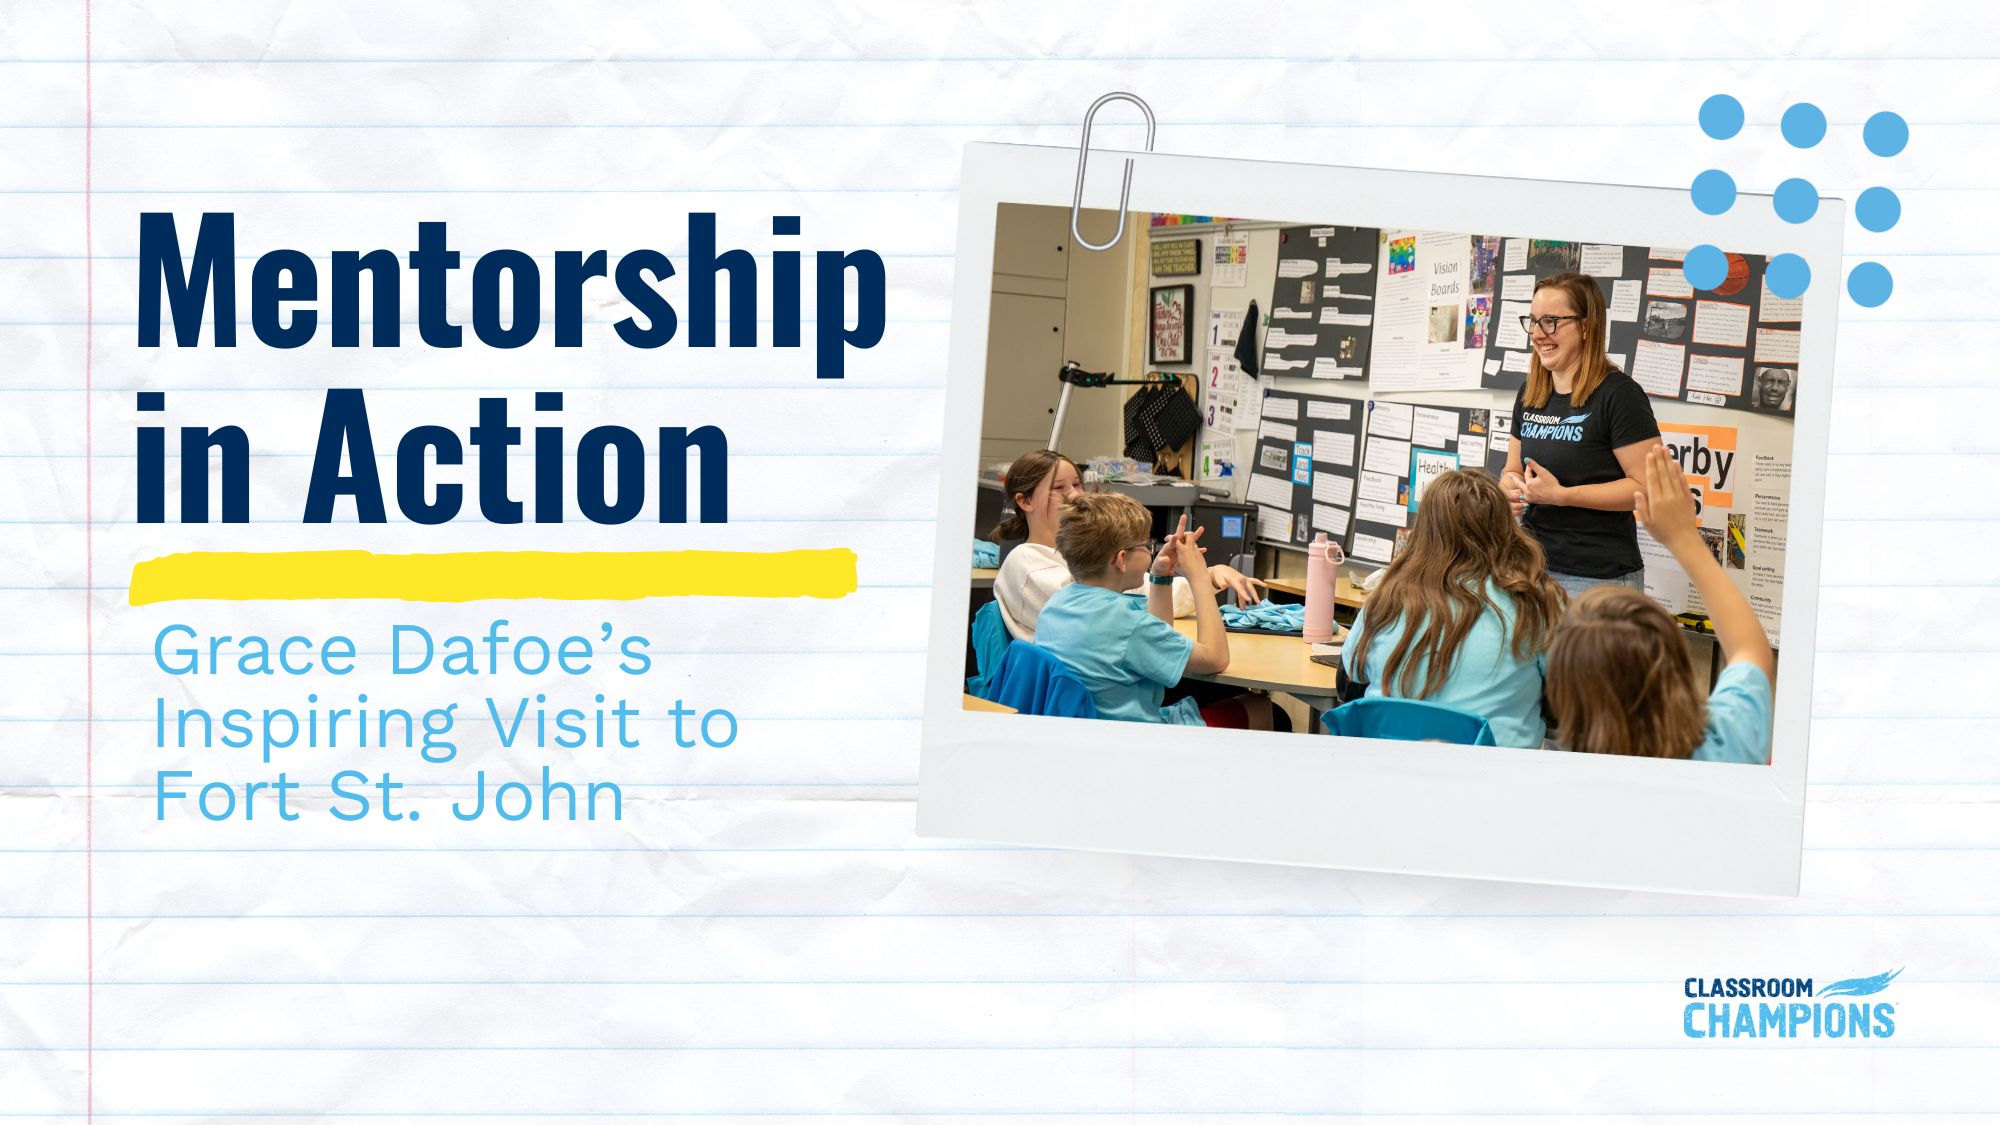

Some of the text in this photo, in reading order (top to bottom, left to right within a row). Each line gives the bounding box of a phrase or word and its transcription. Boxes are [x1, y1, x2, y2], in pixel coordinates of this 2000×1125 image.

[1163, 264, 1172, 272] THE
[1434, 262, 1458, 274] Vision
[1431, 281, 1459, 296] Boards
[1213, 324, 1218, 345] 1
[1211, 366, 1218, 387] 2
[1208, 405, 1215, 426] 3
[1416, 411, 1439, 420] Perseverance
[1523, 412, 1561, 425] CLASSROOM
[1520, 422, 1584, 441] CHAMPIONS
[1296, 445, 1310, 456] Track
[1470, 441, 1483, 449] setting
[1204, 455, 1209, 476] 4
[1298, 460, 1308, 469] and
[1666, 437, 1734, 489] erby
[1364, 475, 1381, 483] Feedback
[1360, 502, 1375, 510] Healthy
[1356, 535, 1376, 544] Leadership
[1751, 595, 1771, 603] Community
